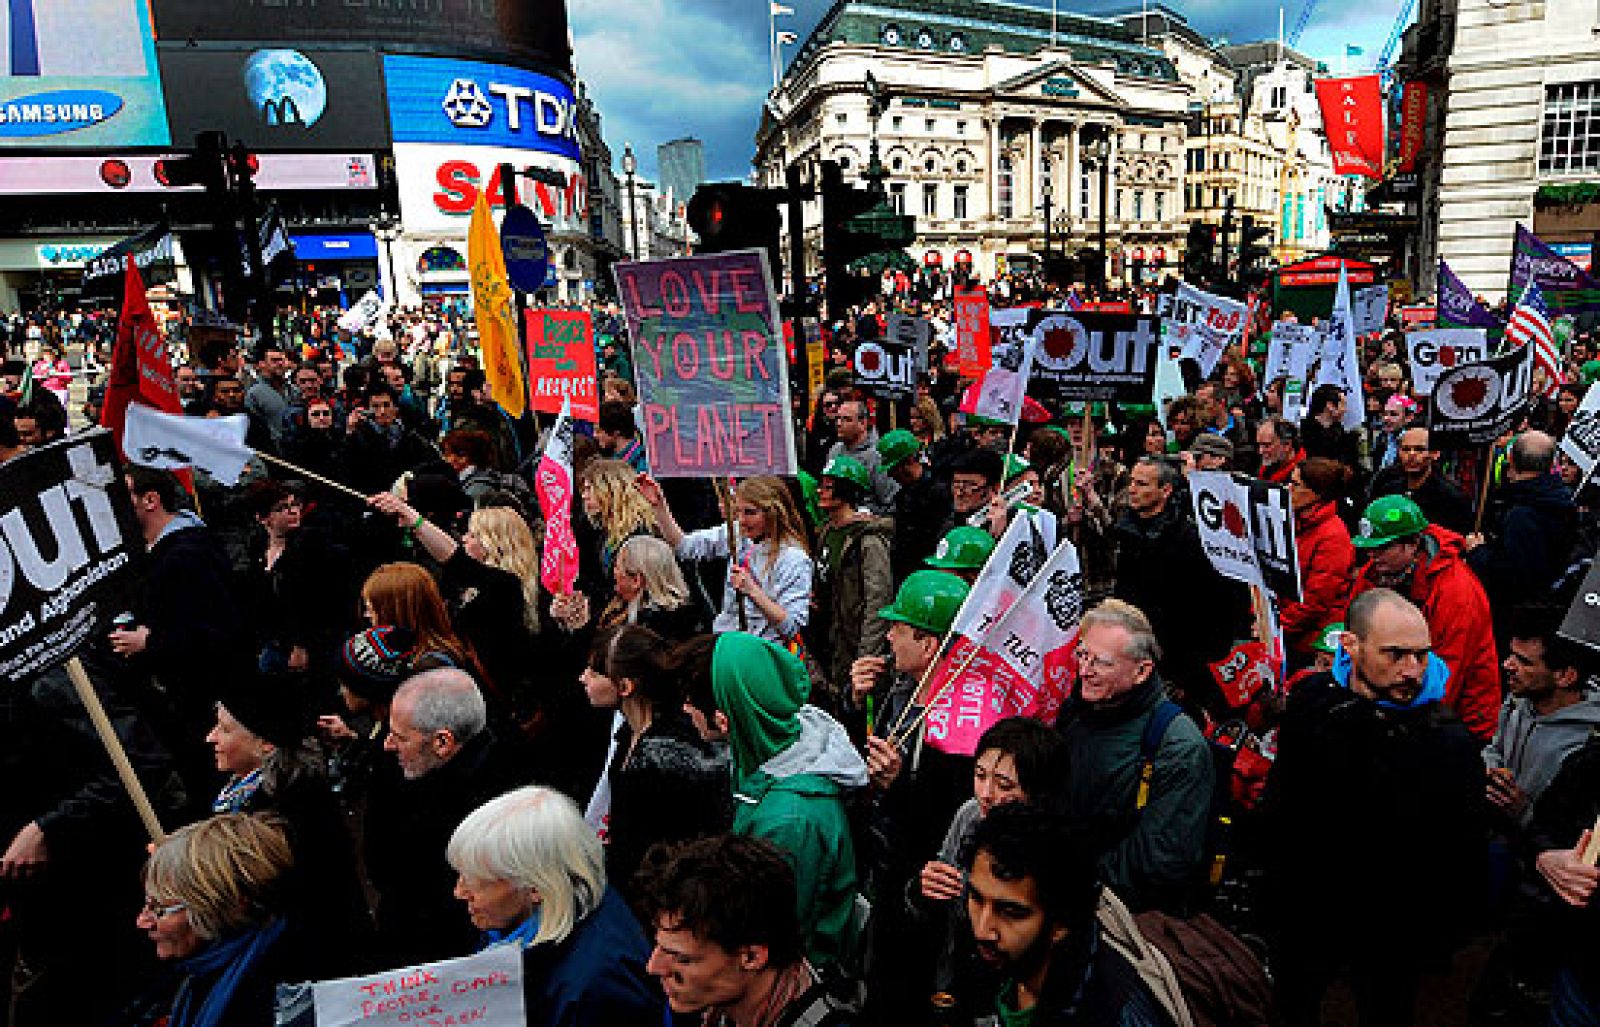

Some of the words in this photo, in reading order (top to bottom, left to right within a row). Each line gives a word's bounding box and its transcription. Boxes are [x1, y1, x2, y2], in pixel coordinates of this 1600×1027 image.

[626, 265, 765, 319] LOVE
[638, 330, 770, 382] YOUR
[854, 342, 914, 384] Out
[1031, 314, 1153, 375] Out
[645, 403, 782, 469] PLANET
[0, 442, 123, 615] ut
[360, 971, 439, 996] THINK
